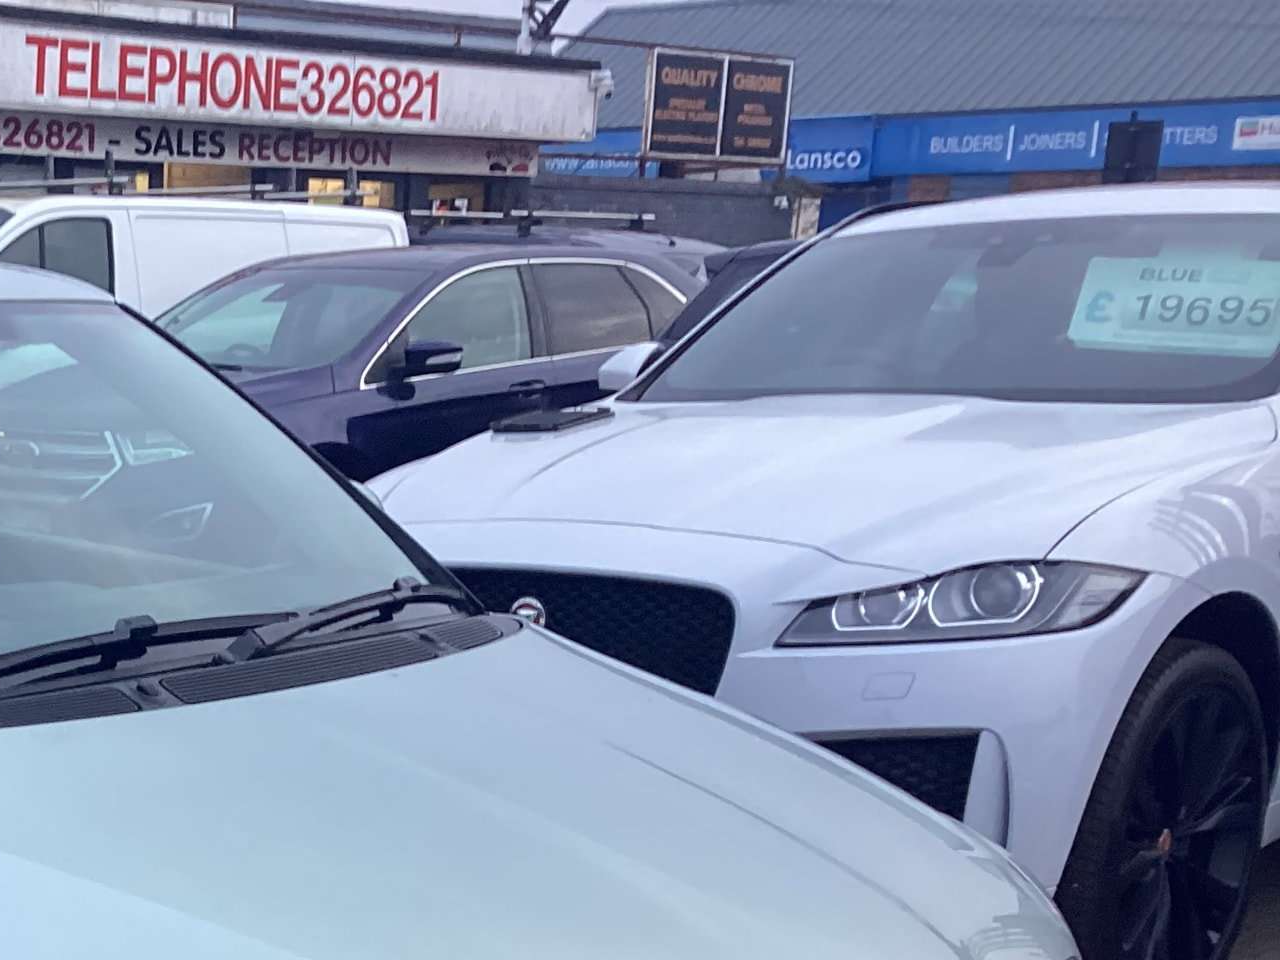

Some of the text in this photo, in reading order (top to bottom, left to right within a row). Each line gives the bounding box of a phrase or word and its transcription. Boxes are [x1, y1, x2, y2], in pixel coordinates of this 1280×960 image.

[662, 66, 718, 88] QUALITY
[134, 126, 226, 159] SALES
[238, 133, 393, 166] RECEPTION
[930, 135, 1004, 154] BUILDERS
[1020, 131, 1086, 151] JOINERS
[1139, 267, 1203, 283] BLUE
[1085, 290, 1274, 327] £ 19695
